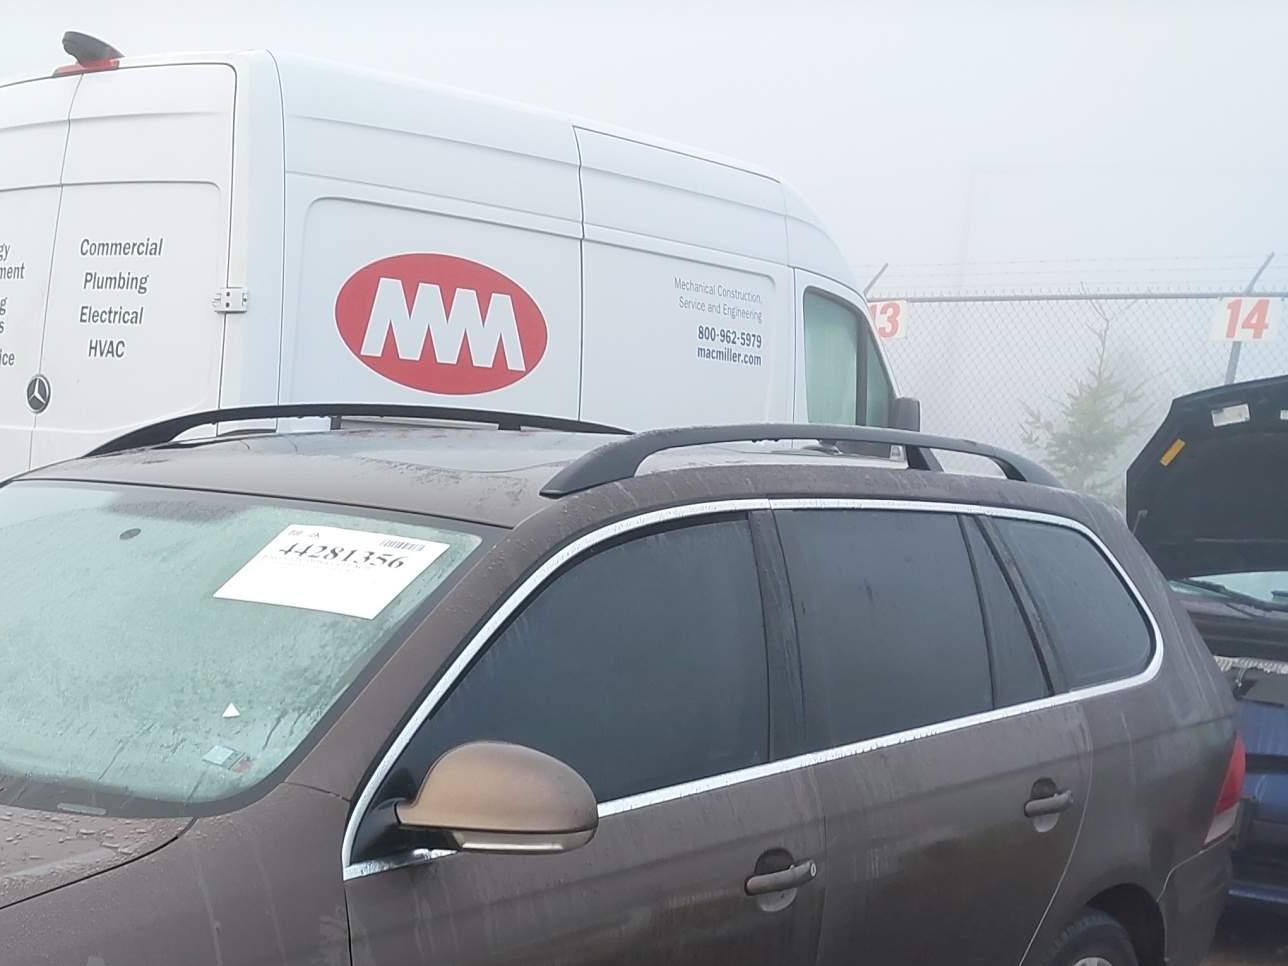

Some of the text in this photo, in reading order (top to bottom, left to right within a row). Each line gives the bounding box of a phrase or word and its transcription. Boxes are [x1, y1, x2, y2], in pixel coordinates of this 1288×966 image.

[79, 238, 164, 256] Commercial
[83, 271, 150, 294] Plumbing
[674, 276, 716, 295] Mechanical
[79, 305, 144, 325] Electrical
[679, 296, 763, 324] Service and Engineering
[1225, 298, 1270, 339] 14
[698, 325, 762, 349] 800-962-5979
[88, 339, 125, 358] HVAC
[697, 346, 762, 367] macmiller.com
[279, 542, 408, 569] 44281356
